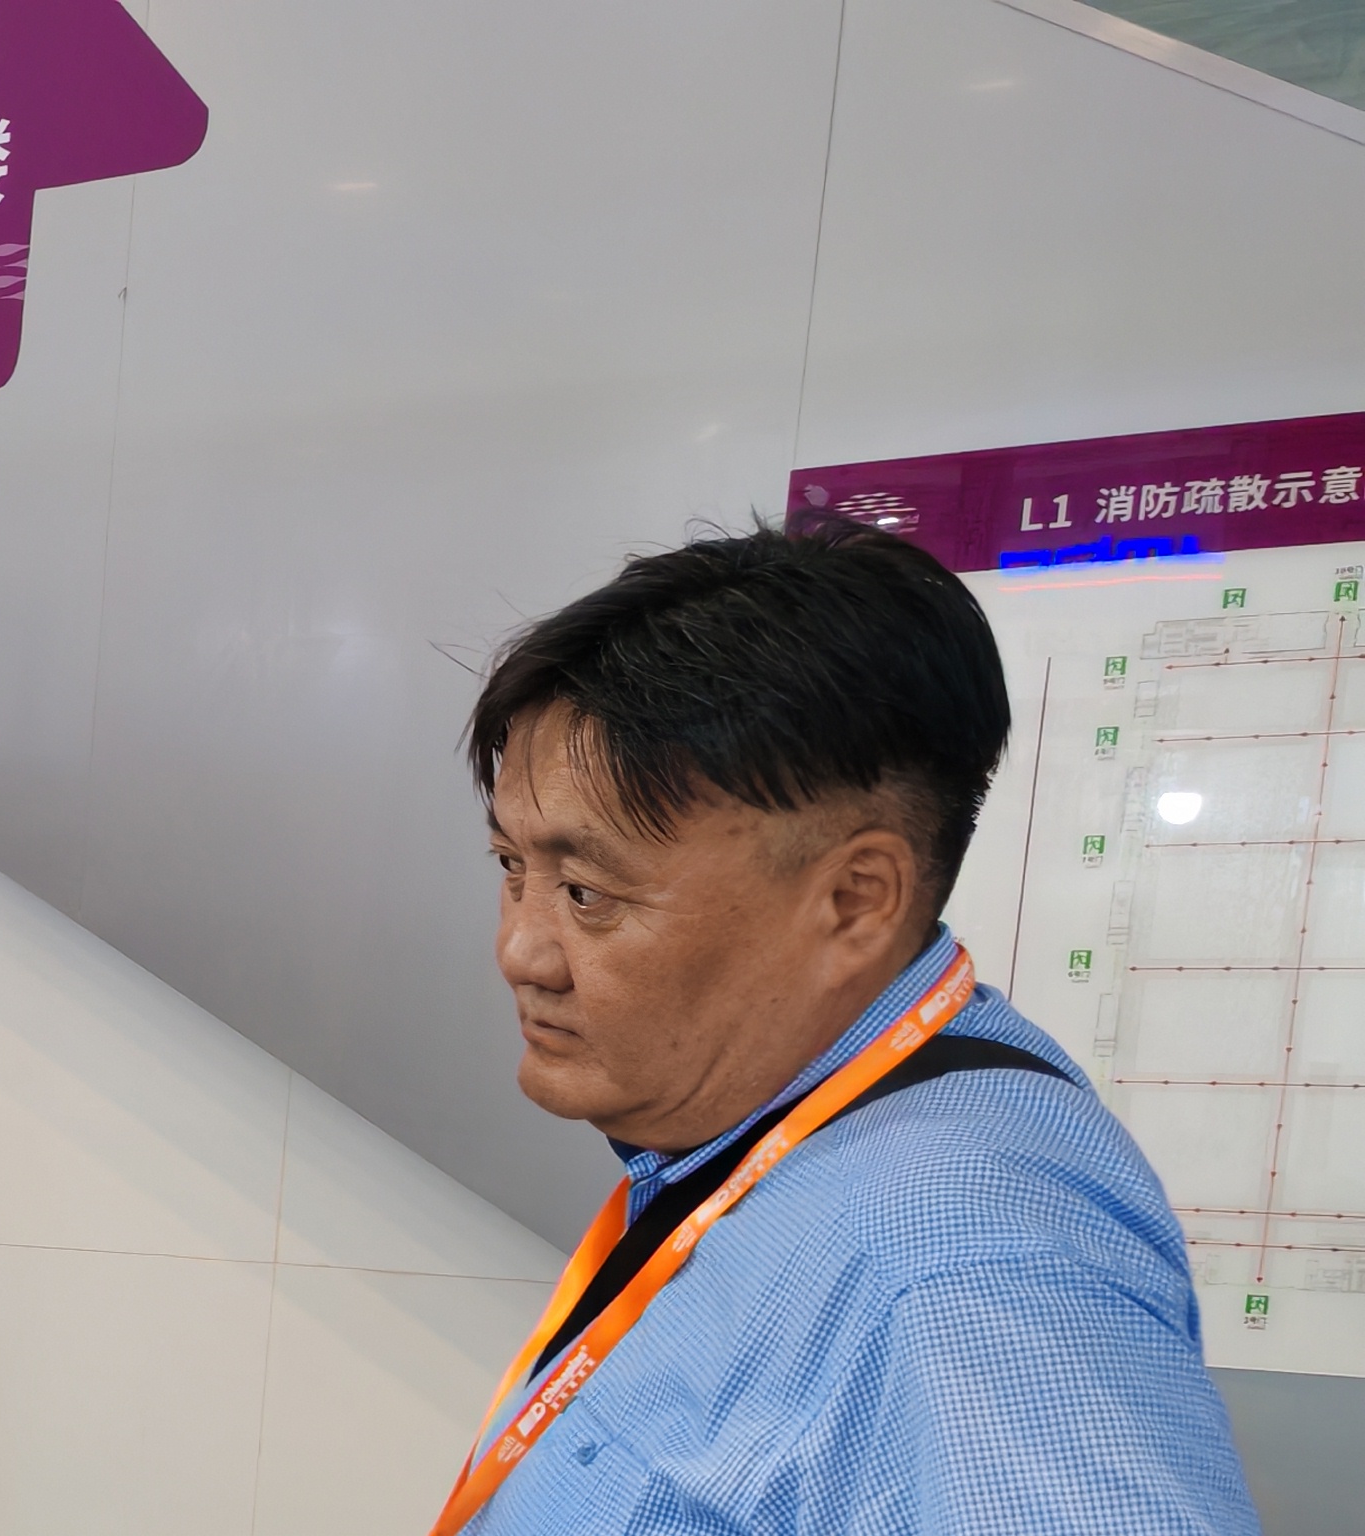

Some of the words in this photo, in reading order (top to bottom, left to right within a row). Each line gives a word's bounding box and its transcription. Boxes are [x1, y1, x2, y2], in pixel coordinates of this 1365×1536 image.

[1020, 494, 1073, 531] L1
[1094, 465, 1364, 524] 消防疏散示意
